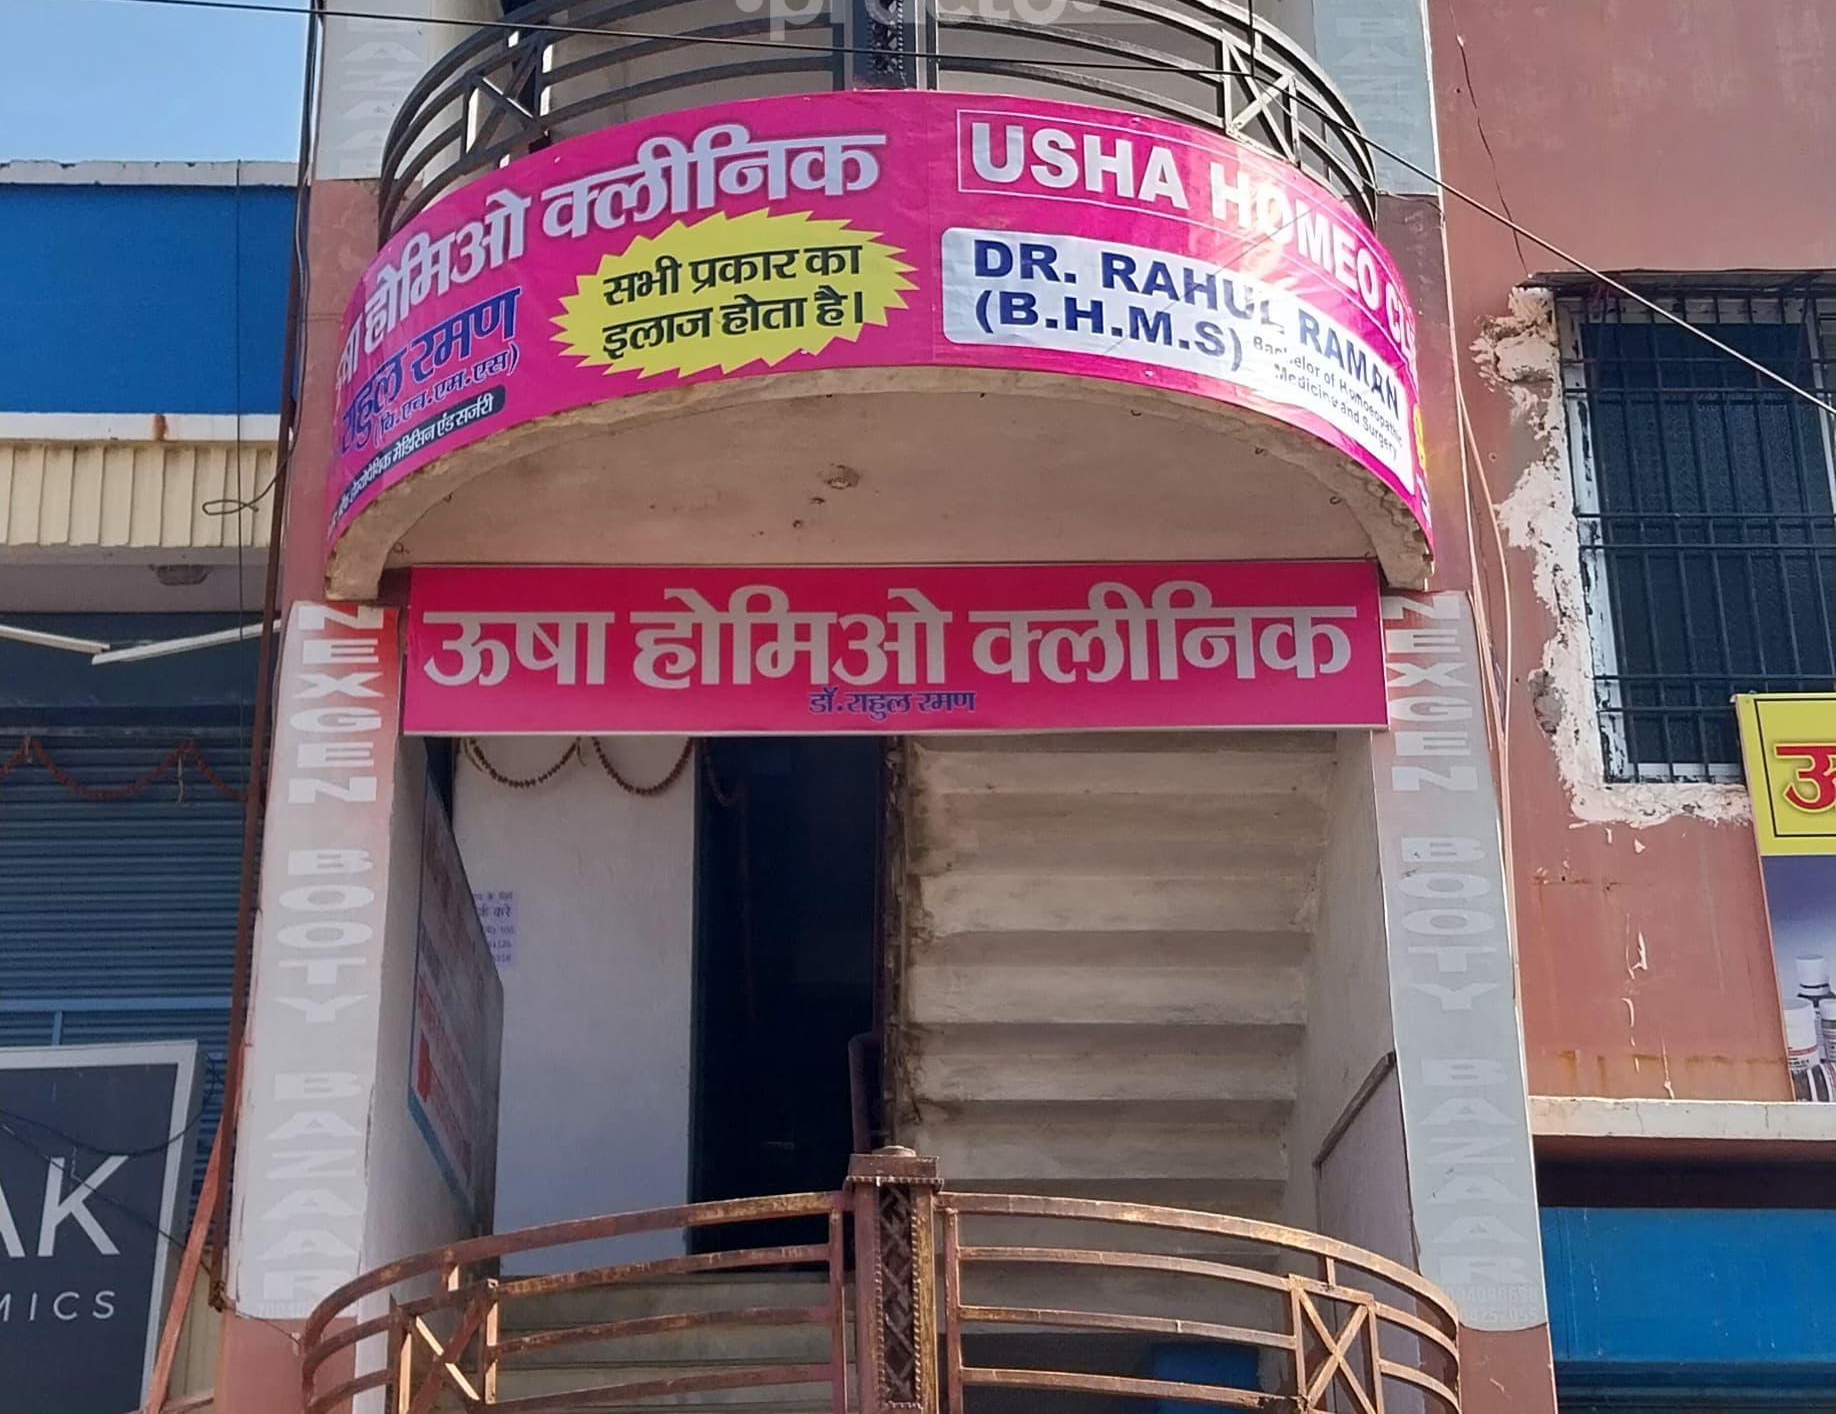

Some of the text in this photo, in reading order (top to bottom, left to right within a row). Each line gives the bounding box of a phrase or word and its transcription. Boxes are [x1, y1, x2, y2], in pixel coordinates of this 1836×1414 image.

[362, 190, 532, 356] होमिओ
[541, 123, 886, 239] क्लीनिक
[970, 122, 1190, 212] USHA
[1208, 161, 1378, 313] HOMEO
[602, 244, 863, 308] सभी प्रकार का
[409, 288, 523, 383] रमण
[602, 306, 713, 357] इलाज
[719, 294, 806, 338] होता
[973, 239, 1402, 421] DR. RAHUL RAMAN
[975, 290, 1244, 372] (B.H.M.S)
[1324, 371, 1336, 387] of
[1341, 402, 1360, 424] and
[422, 580, 1357, 688] ऊषा होमिओ क्लीनिक
[916, 692, 976, 713] रमण
